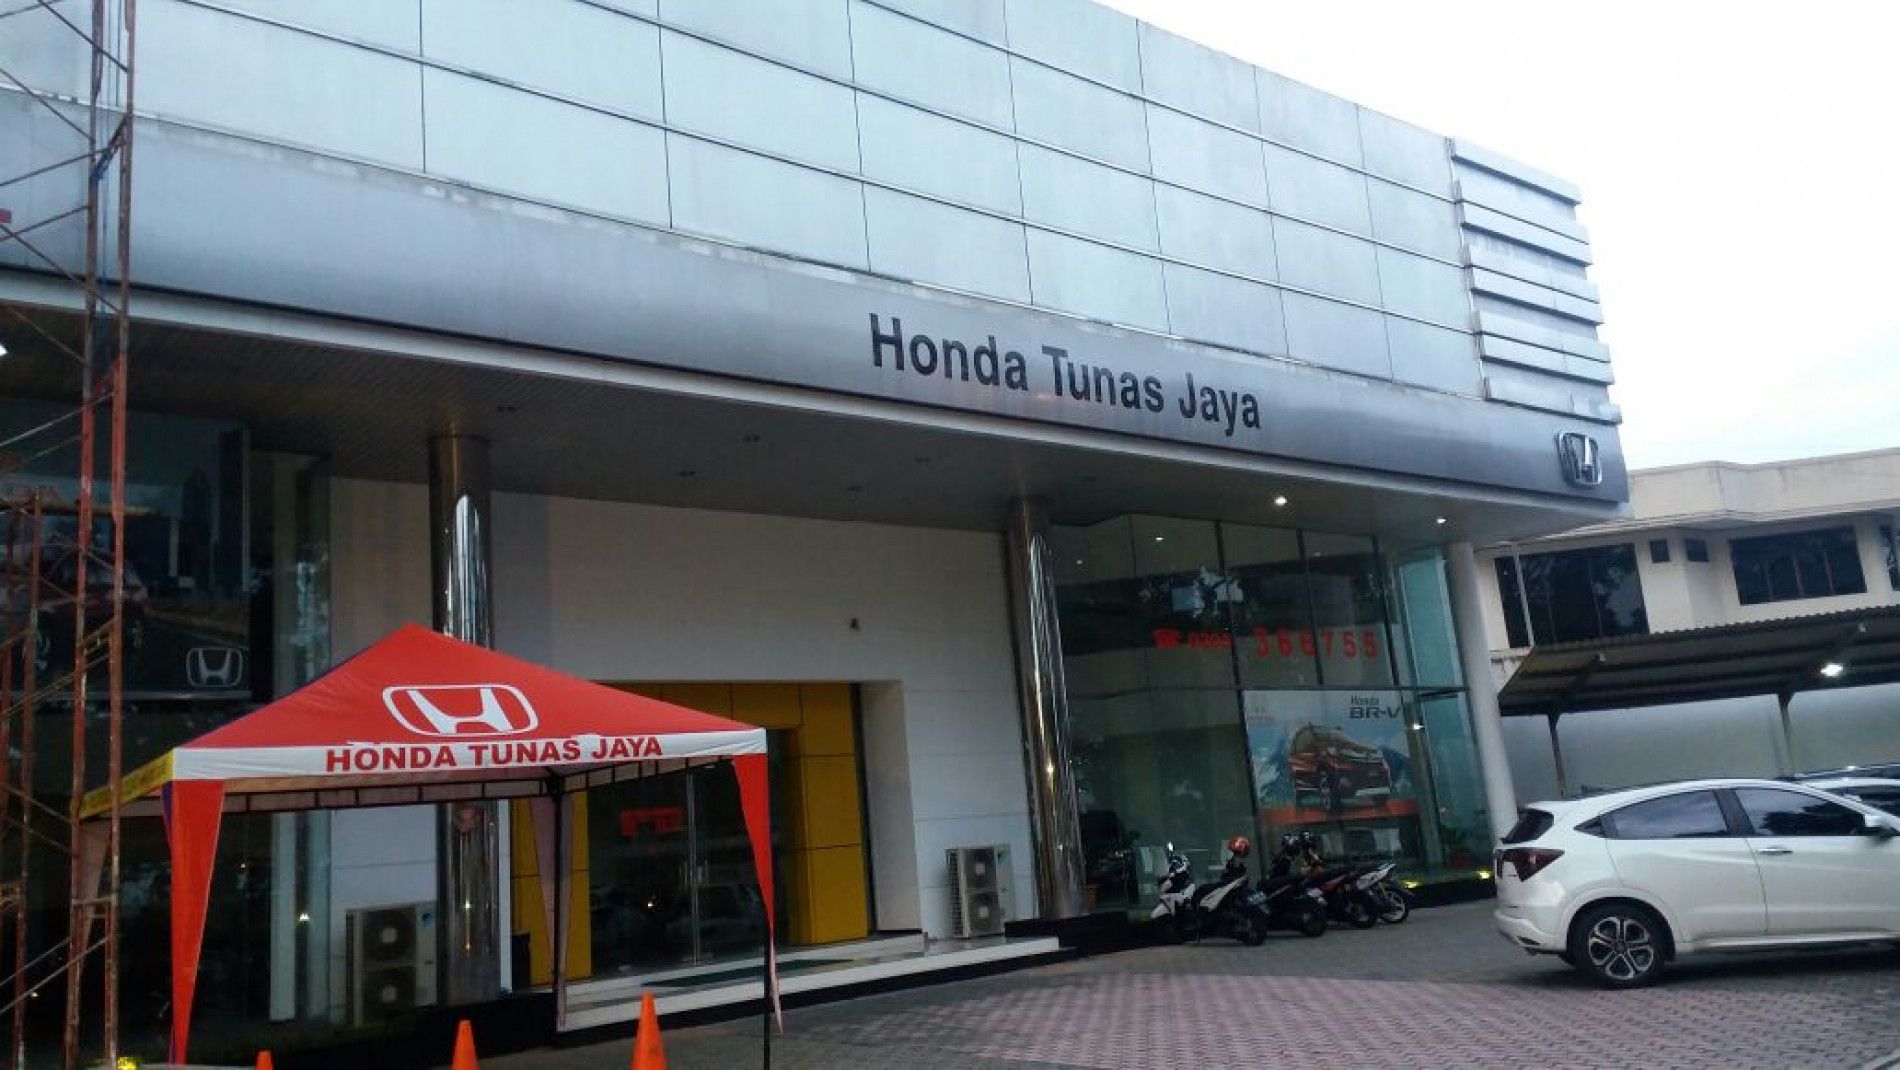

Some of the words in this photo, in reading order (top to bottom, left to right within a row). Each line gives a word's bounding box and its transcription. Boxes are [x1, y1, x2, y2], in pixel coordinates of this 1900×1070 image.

[869, 312, 1029, 392] Honda
[1041, 344, 1165, 414] Tunas
[1178, 371, 1262, 437] Jaya
[1350, 706, 1400, 719] BR-V
[326, 745, 458, 773] HONDA
[469, 739, 581, 768] TUNAS
[592, 735, 663, 760] JAYA
